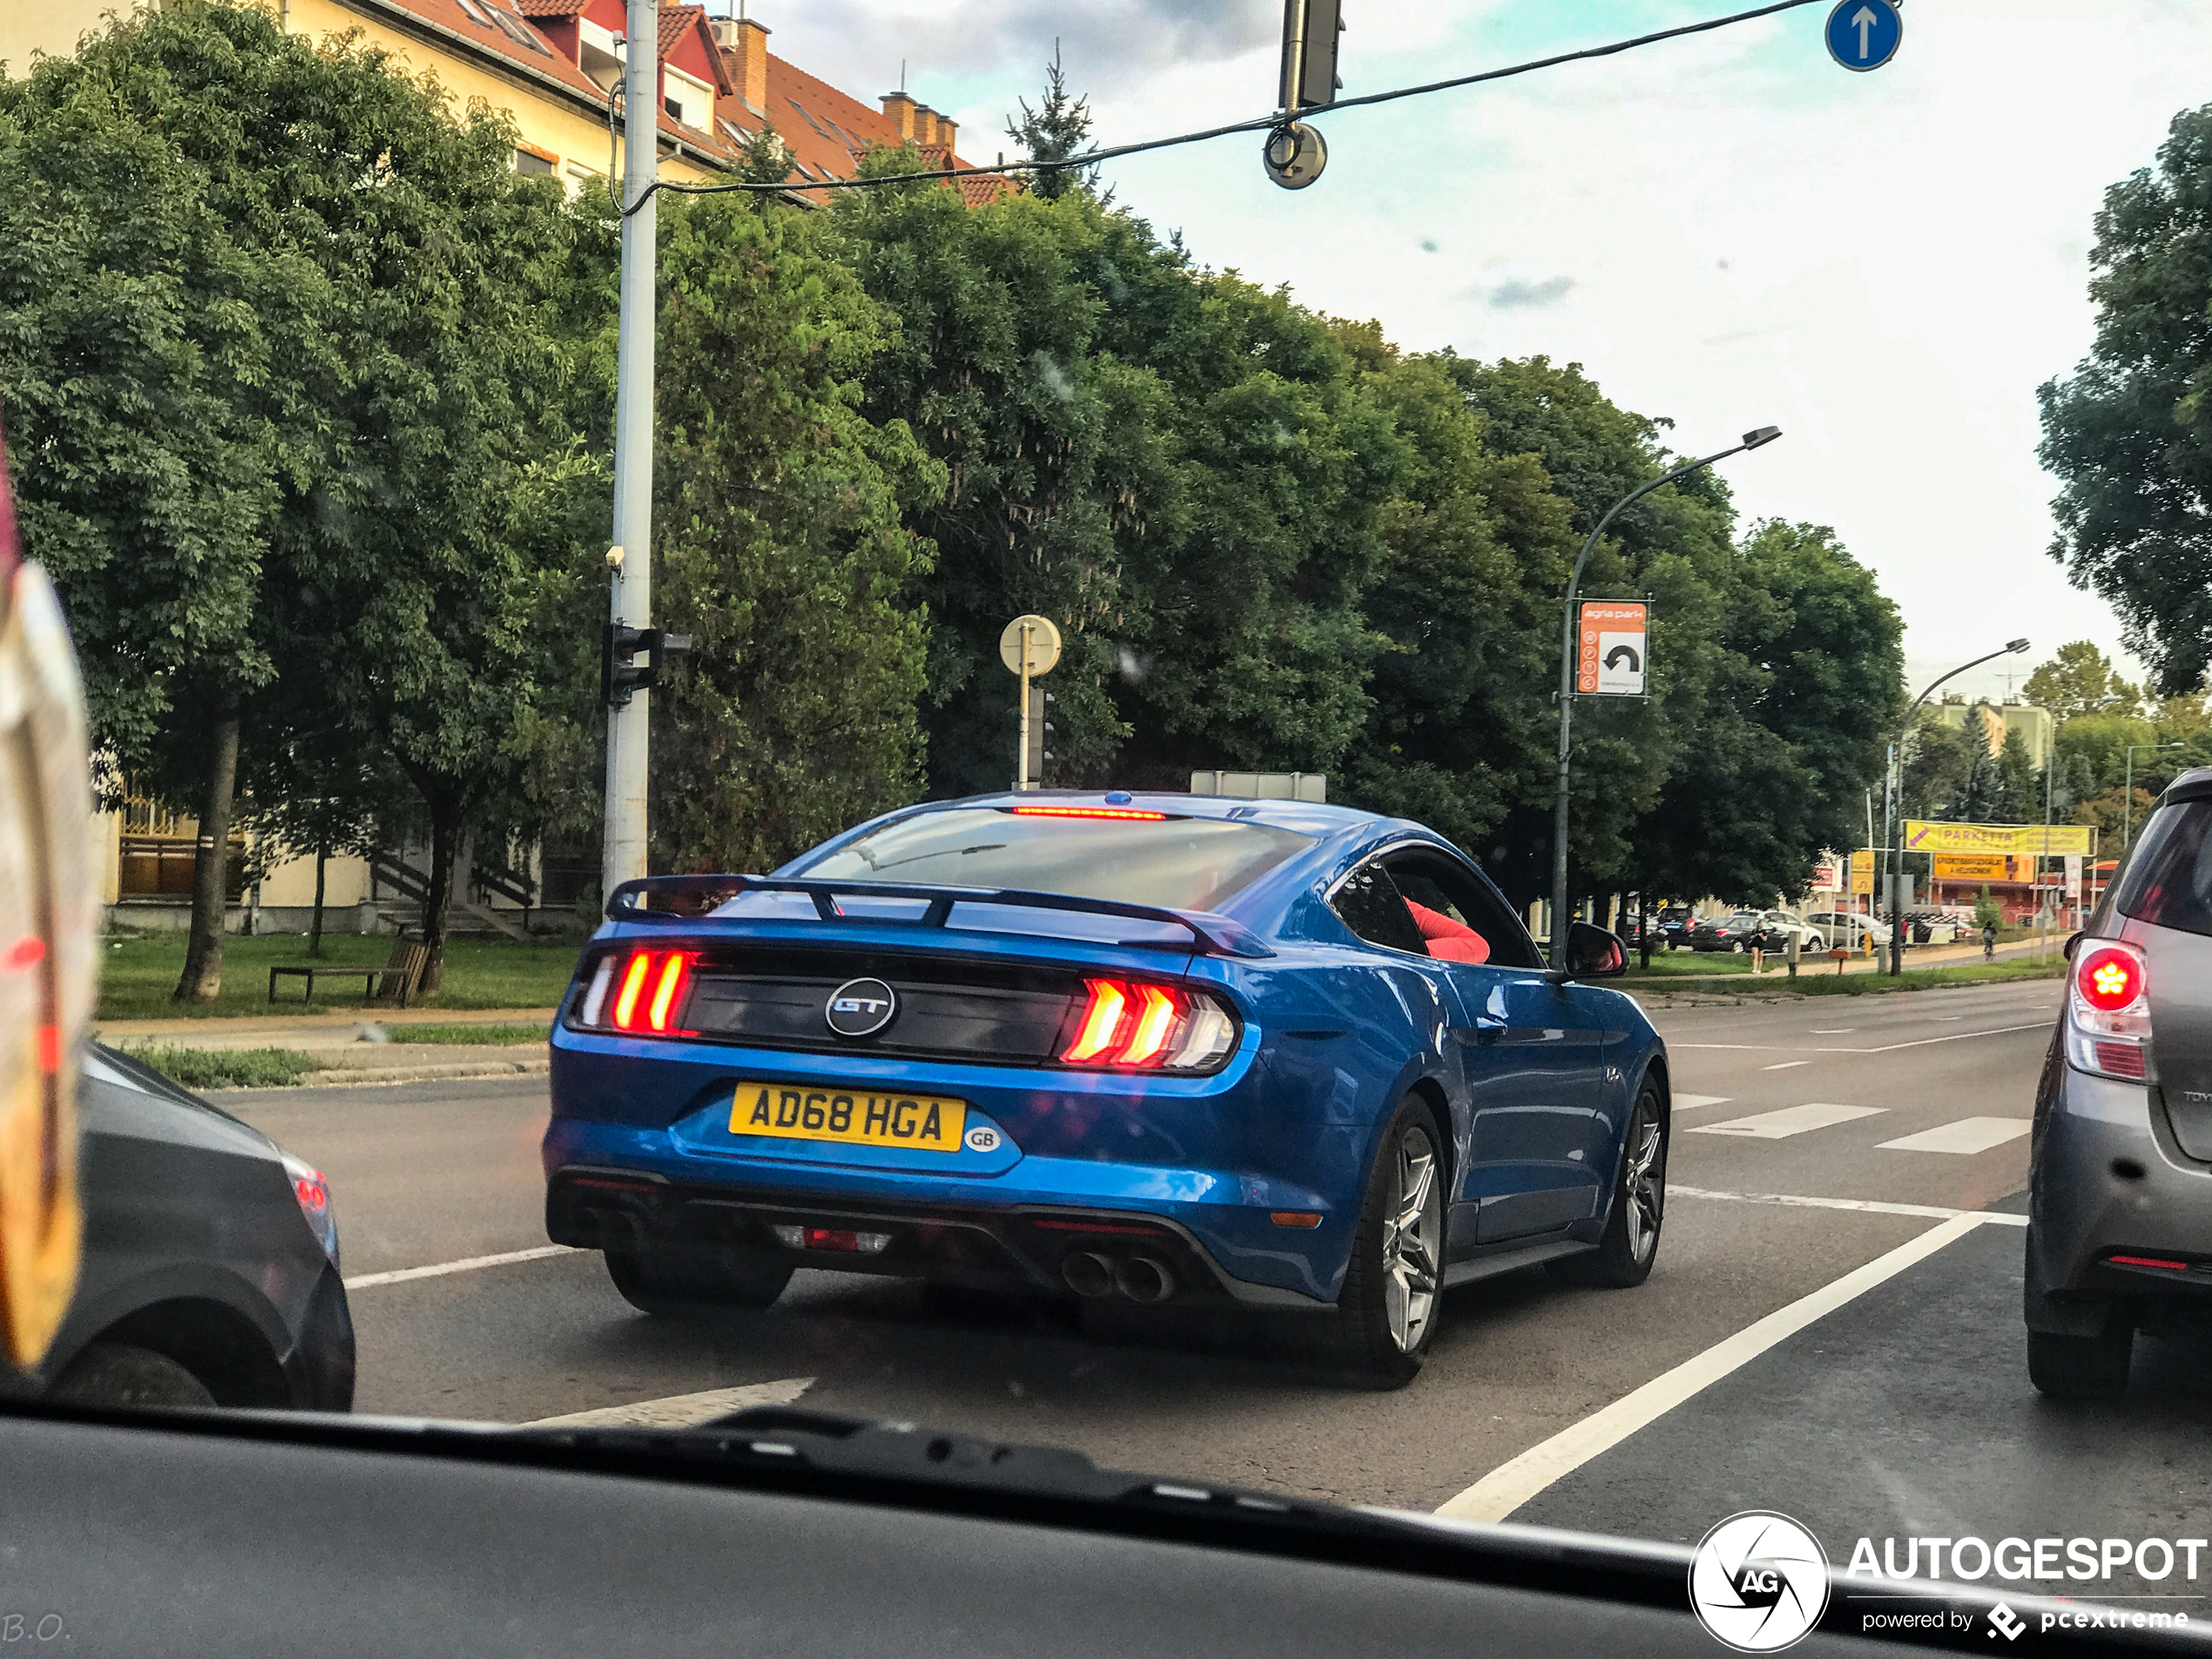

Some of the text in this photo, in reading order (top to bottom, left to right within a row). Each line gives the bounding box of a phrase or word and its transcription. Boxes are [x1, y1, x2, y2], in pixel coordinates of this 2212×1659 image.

[1615, 610, 1643, 619] park
[1944, 830, 2013, 842] PARKETTA
[833, 997, 888, 1014] GT
[750, 1089, 942, 1142] AD68 HGA
[971, 1131, 995, 1148] GB
